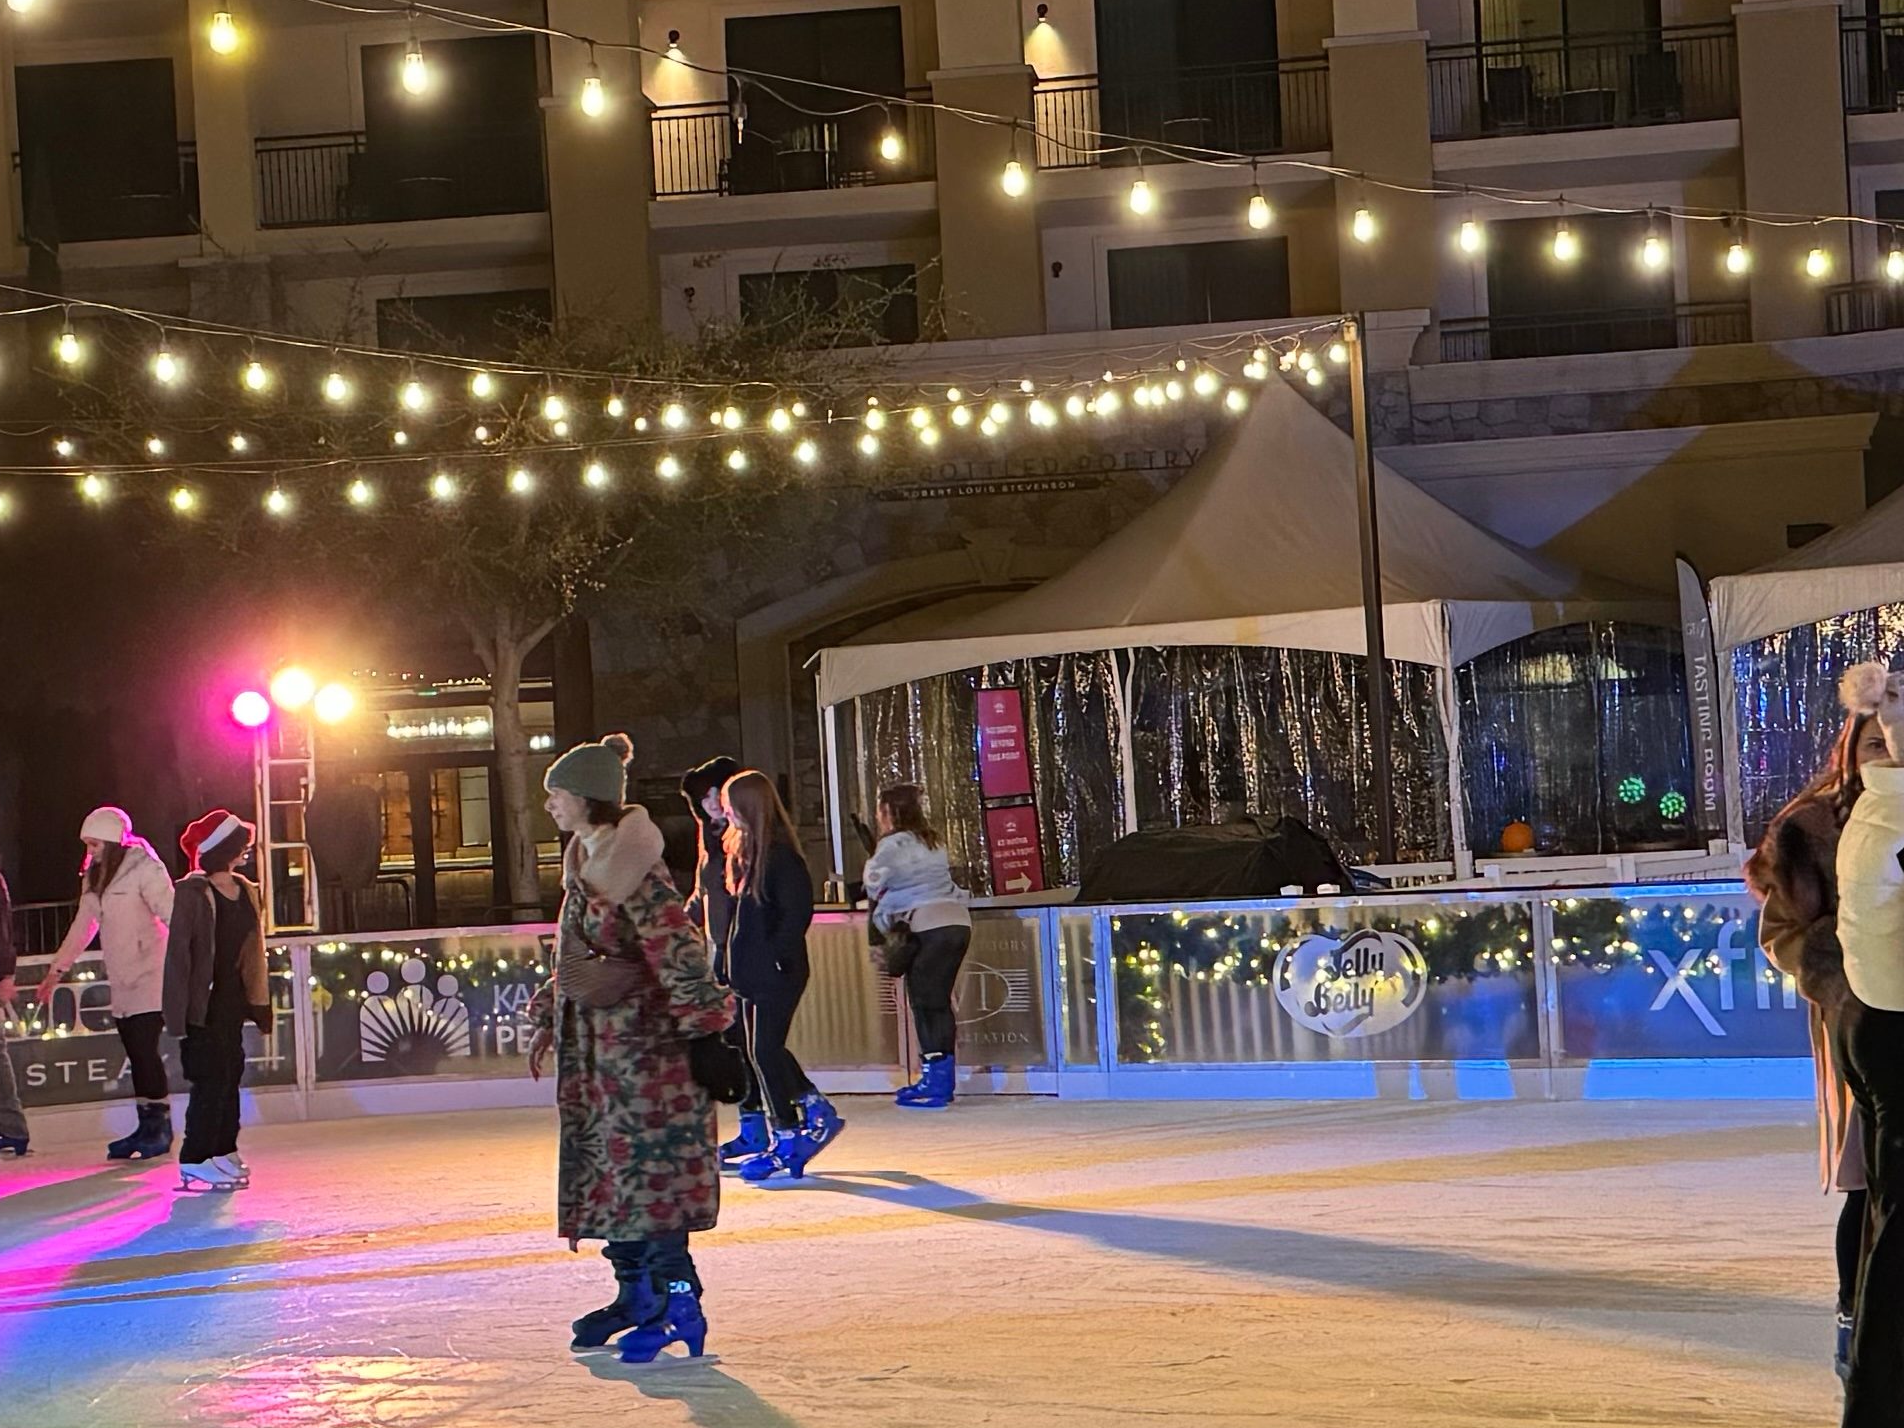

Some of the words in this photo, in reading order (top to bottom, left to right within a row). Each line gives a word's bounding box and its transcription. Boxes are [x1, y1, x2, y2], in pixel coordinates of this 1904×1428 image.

[1077, 447, 1200, 470] POETRY
[903, 487, 952, 498] ROBERT
[958, 483, 996, 495] LOUIS
[1001, 480, 1076, 493] STEVENSON
[1323, 947, 1385, 983] Jelly
[1303, 981, 1375, 1018] Belly
